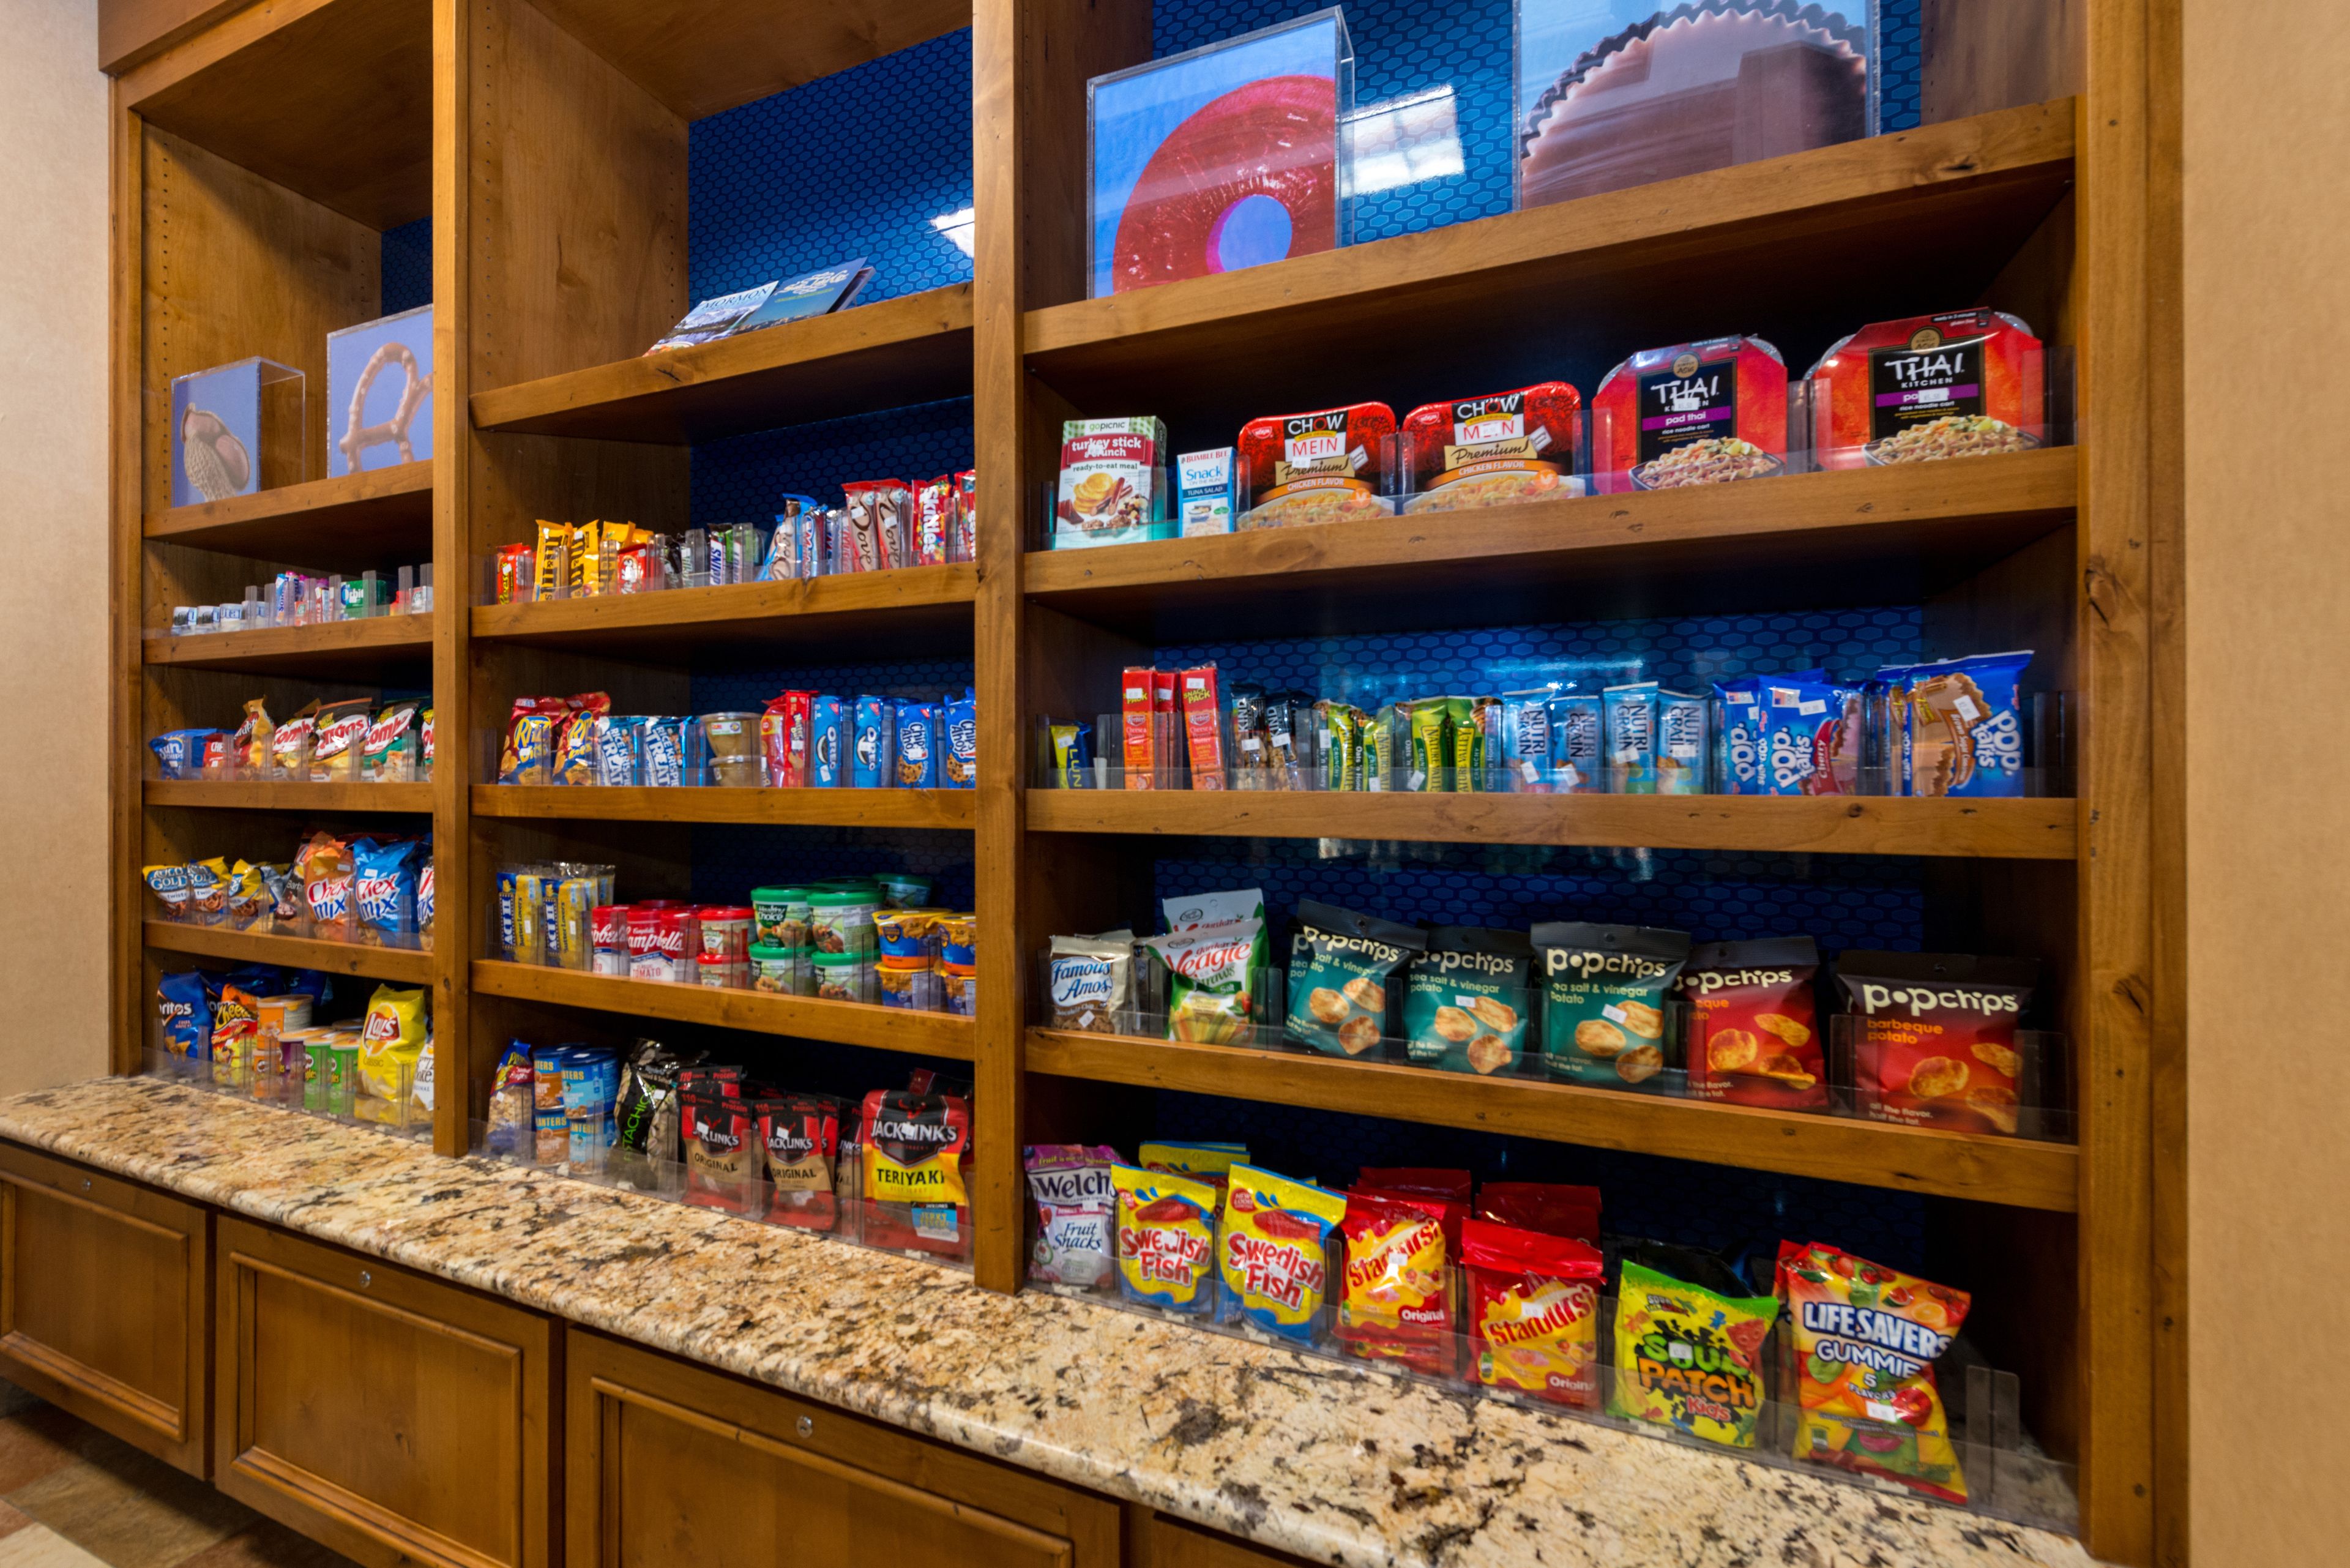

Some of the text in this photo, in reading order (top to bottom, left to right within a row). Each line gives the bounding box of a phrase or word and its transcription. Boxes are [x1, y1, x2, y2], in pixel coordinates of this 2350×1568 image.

[703, 287, 771, 310] MORMON
[1884, 353, 1963, 381] THAI
[1651, 376, 1718, 404] THAI
[1901, 378, 1953, 388] KITCHEN
[1457, 394, 1519, 419] CHOW
[1665, 400, 1709, 412] KIEN
[1288, 414, 1344, 435] CHOW
[1666, 411, 1706, 425] pad thai
[1463, 420, 1514, 441] MN
[1072, 437, 1141, 452] turkey stick
[1292, 438, 1338, 456] MEIN
[1451, 440, 1529, 464] Premium
[1073, 463, 1117, 472] ready-to-eat
[1186, 453, 1214, 463] BUMBLE
[1458, 460, 1524, 476] CHICKEN FLAVOR
[1186, 467, 1223, 481] Snack
[1281, 459, 1349, 480] Premium
[1288, 477, 1344, 491] CHICKEN FLAVOR
[920, 485, 941, 554] Skittles
[1183, 687, 1206, 700] SNACK
[1188, 691, 1210, 703] PACK
[1237, 699, 1247, 733] KIND
[1950, 714, 1966, 734] Brown
[611, 728, 625, 747] RICE
[655, 726, 673, 747] RICE
[1518, 711, 1532, 755] GRAIN
[1530, 709, 1546, 755] NUTRI
[1569, 713, 1584, 758] GRAIN
[1582, 713, 1596, 758] NUTRI
[1630, 705, 1648, 751] NUTRI
[827, 726, 837, 771] OREO
[867, 726, 877, 772] OREO
[1458, 729, 1471, 763] VALLEY
[1795, 734, 1816, 777] tarts
[1970, 723, 1996, 769] tarts
[1817, 739, 1828, 779] Cherry
[1319, 765, 1328, 788] Honey
[151, 875, 187, 890] GOLD
[307, 875, 352, 903] Chex
[313, 896, 346, 920] mix
[360, 892, 398, 920] mix
[758, 911, 785, 921] Choice
[503, 917, 513, 946] ACT
[1291, 953, 1340, 968] sea salt &
[1050, 958, 1110, 986] Famous
[1059, 978, 1108, 1002] Amos
[1220, 983, 1234, 994] Salt
[1409, 973, 1500, 994] sea salt & vinegar
[1410, 984, 1442, 993] potato
[1570, 983, 1649, 998] salt & vinegar
[159, 1002, 192, 1015] ritos
[365, 1014, 397, 1040] Lay's
[1867, 1018, 1944, 1035] barbeque
[1867, 1030, 1918, 1045] potato
[722, 1103, 748, 1113] Protein
[871, 1119, 905, 1140] JACK
[695, 1152, 738, 1173] ORIGINAL
[772, 1168, 817, 1179] ORIGINAL
[876, 1168, 944, 1185] TERIYAKI
[1034, 1171, 1119, 1198] Welch
[1065, 1222, 1098, 1236] Fruit
[1053, 1234, 1102, 1250] Snacks
[1140, 1251, 1191, 1285] Fish
[1228, 1233, 1326, 1293] Swedish
[1245, 1263, 1302, 1310] Fish
[1401, 1309, 1444, 1322] Original
[1643, 1333, 1749, 1379] SOUR
[1636, 1356, 1755, 1409] PATCH
[1864, 1373, 1877, 1387] 5
[1686, 1396, 1731, 1422] Kids
